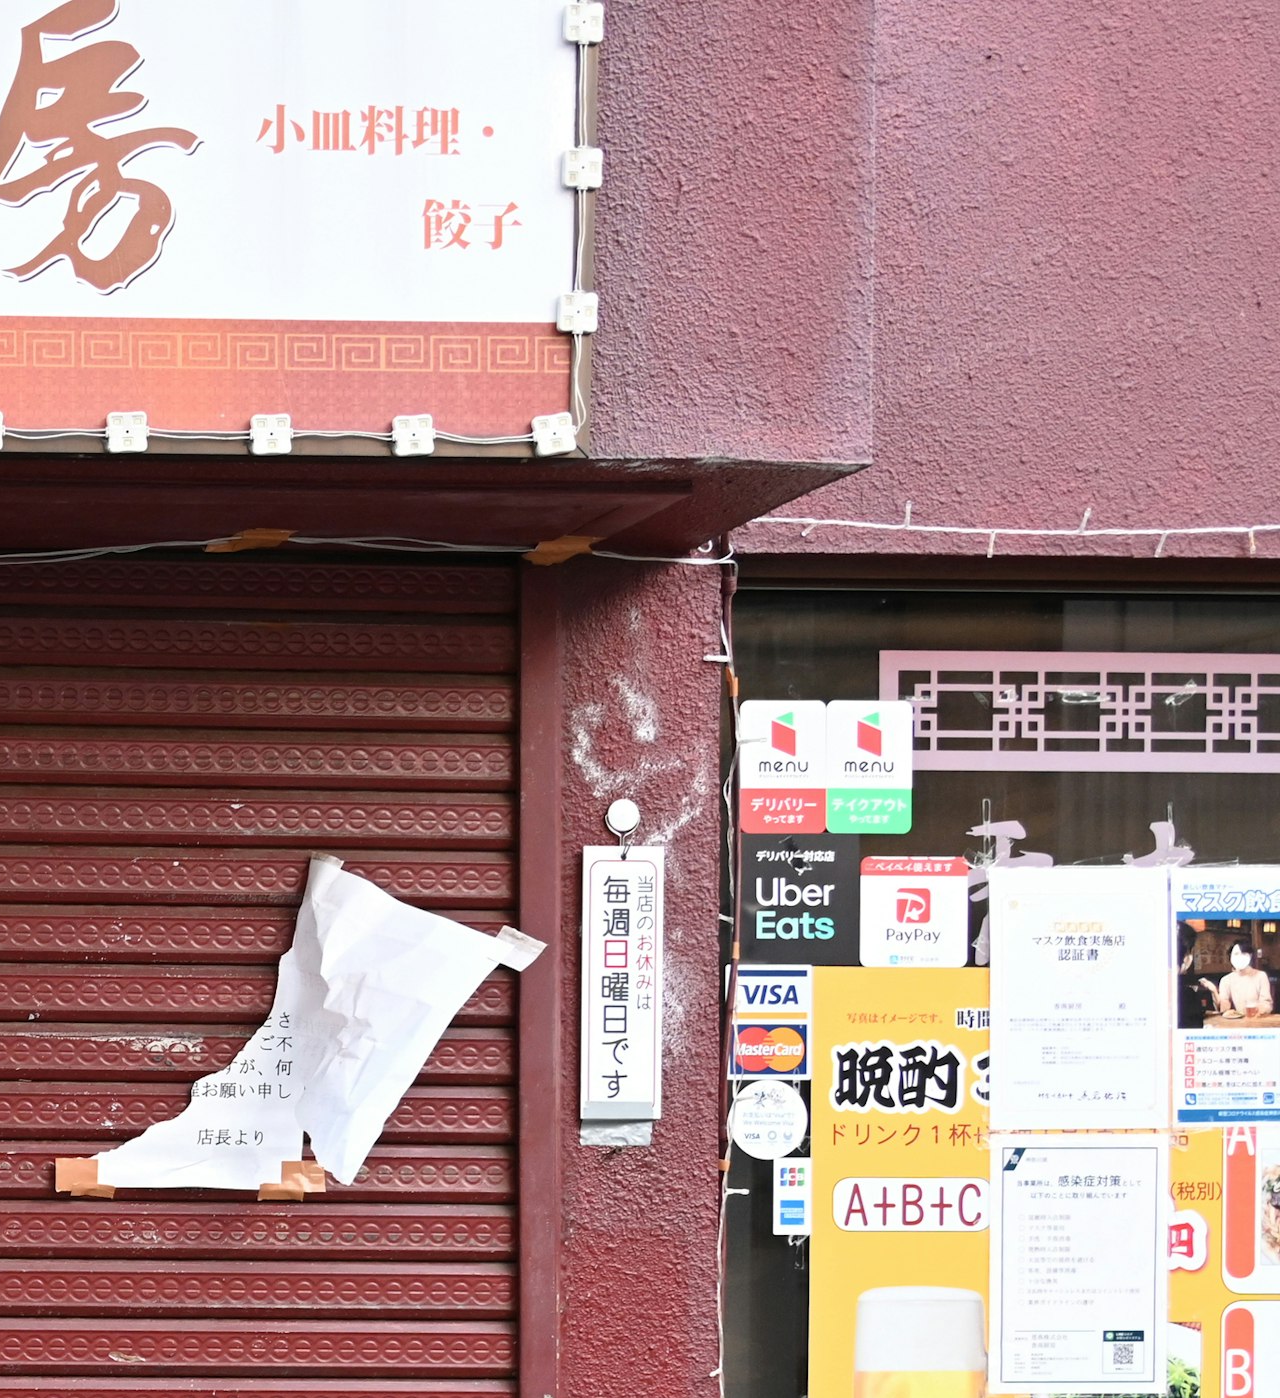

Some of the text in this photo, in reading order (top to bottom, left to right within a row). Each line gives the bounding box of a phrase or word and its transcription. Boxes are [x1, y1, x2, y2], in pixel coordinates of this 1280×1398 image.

[421, 198, 524, 251] 餃子
[758, 760, 809, 773] menu
[843, 760, 895, 773] menu
[750, 797, 818, 812] デリバリー
[831, 799, 909, 812] テイクアウト
[762, 814, 805, 825] やってます
[848, 814, 891, 825] やってます
[755, 877, 836, 907] Uber
[755, 910, 836, 940] Eats
[635, 875, 654, 1011] 当店のお休みは
[885, 928, 941, 945] PayPay
[1031, 935, 1126, 947] マスク飲食実施店
[601, 875, 632, 1099] 毎週日曜日です
[738, 984, 799, 1005] VISA
[846, 1012, 944, 1024] 写真はイメージです。
[736, 1042, 803, 1057] MasterCard
[835, 1046, 960, 1109] 晩酌
[196, 1128, 265, 1147] 店長より
[744, 1132, 761, 1140] VISA
[843, 1182, 982, 1227] A+B+C
[1224, 1348, 1253, 1398] B
